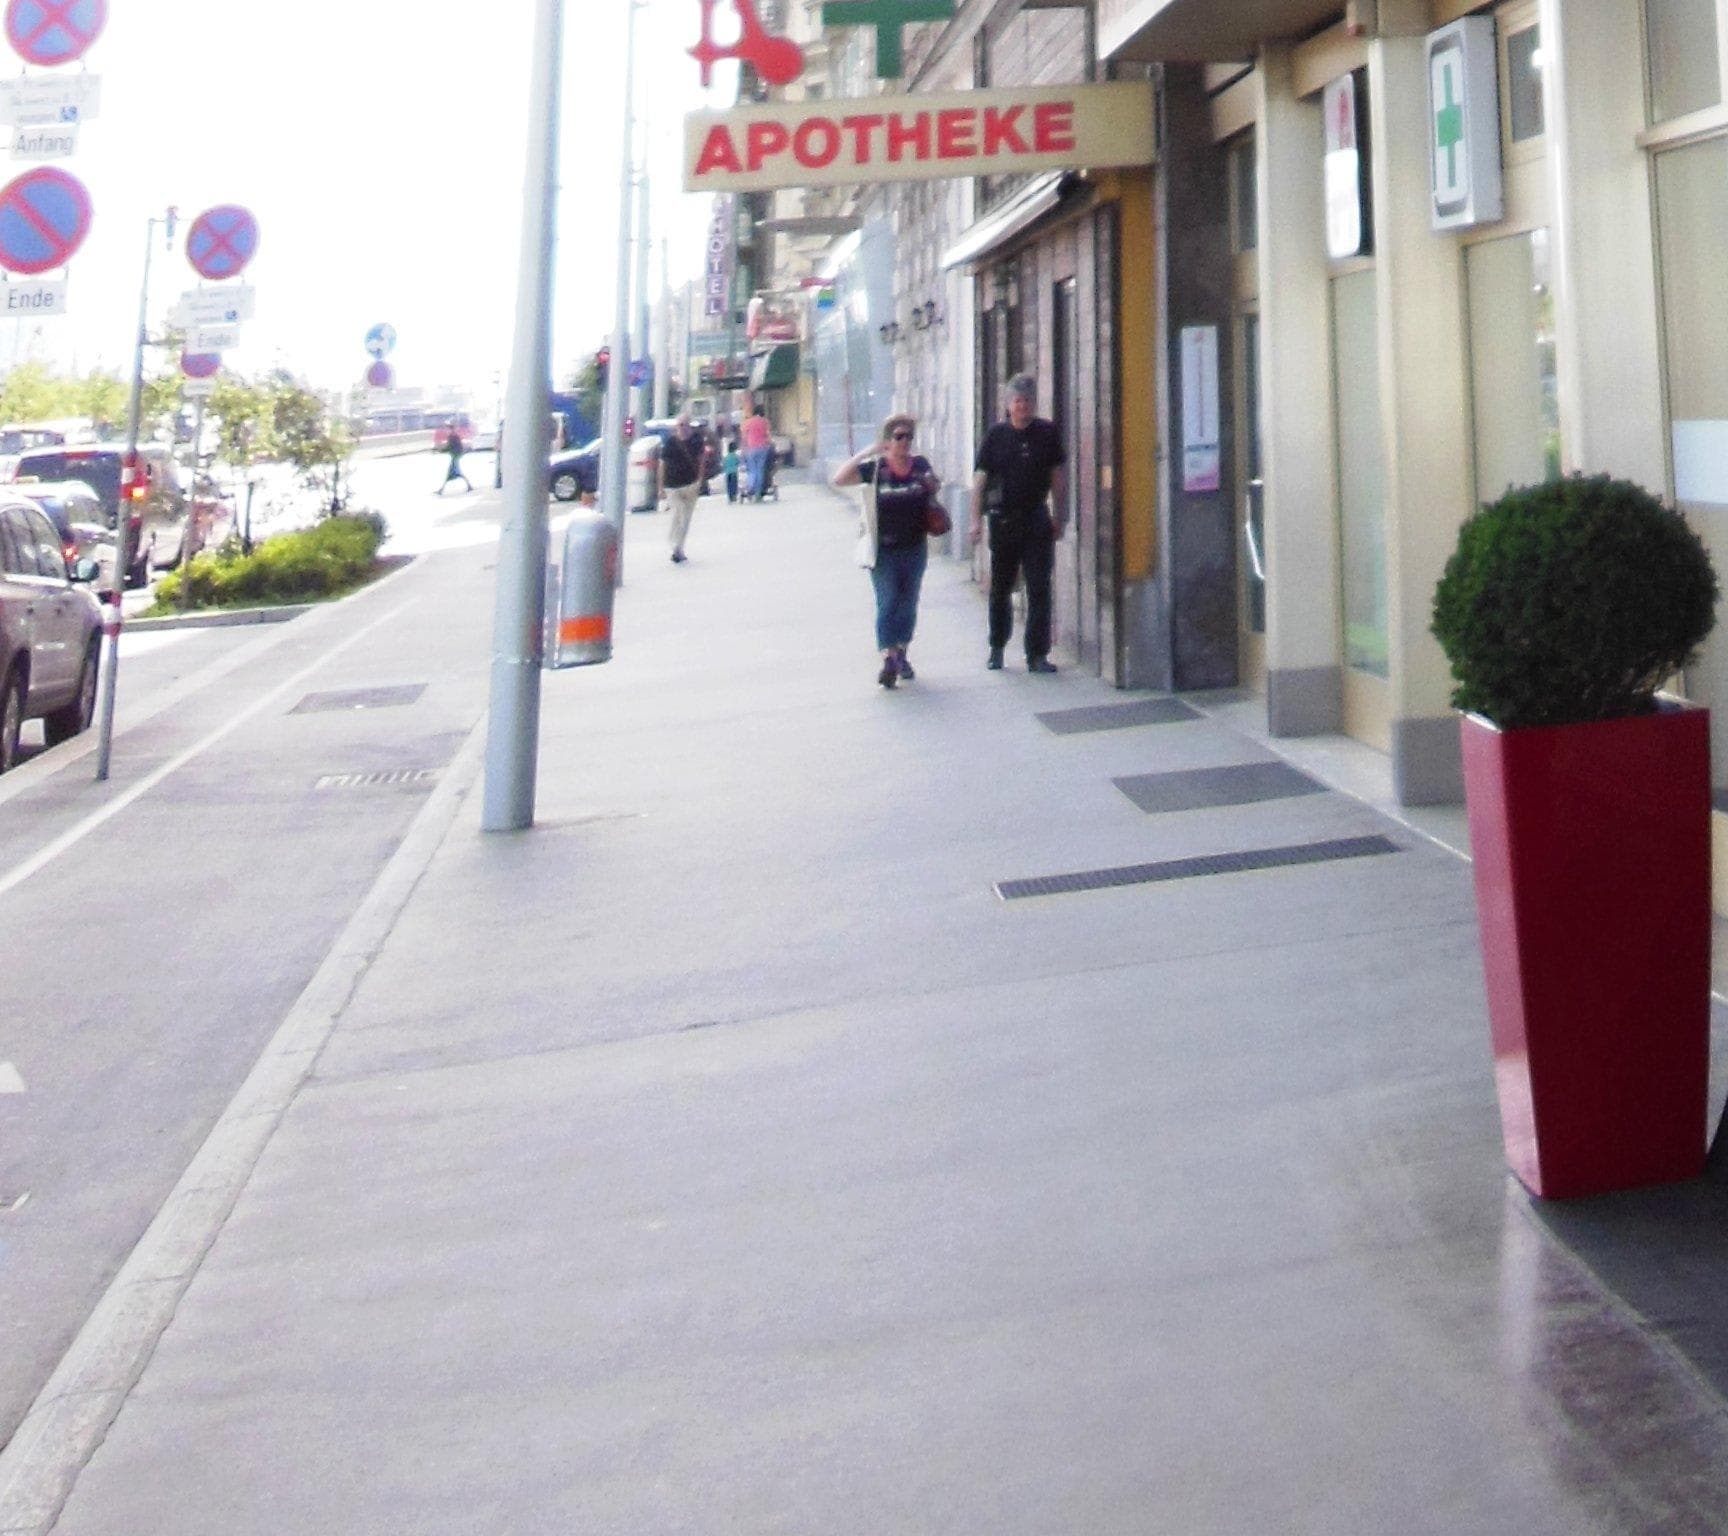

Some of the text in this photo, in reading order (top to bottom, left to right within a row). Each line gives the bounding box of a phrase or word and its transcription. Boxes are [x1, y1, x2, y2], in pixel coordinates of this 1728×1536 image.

[17, 133, 74, 156] Anfang
[694, 101, 1077, 175] APOTHEKE
[8, 288, 54, 309] Ende
